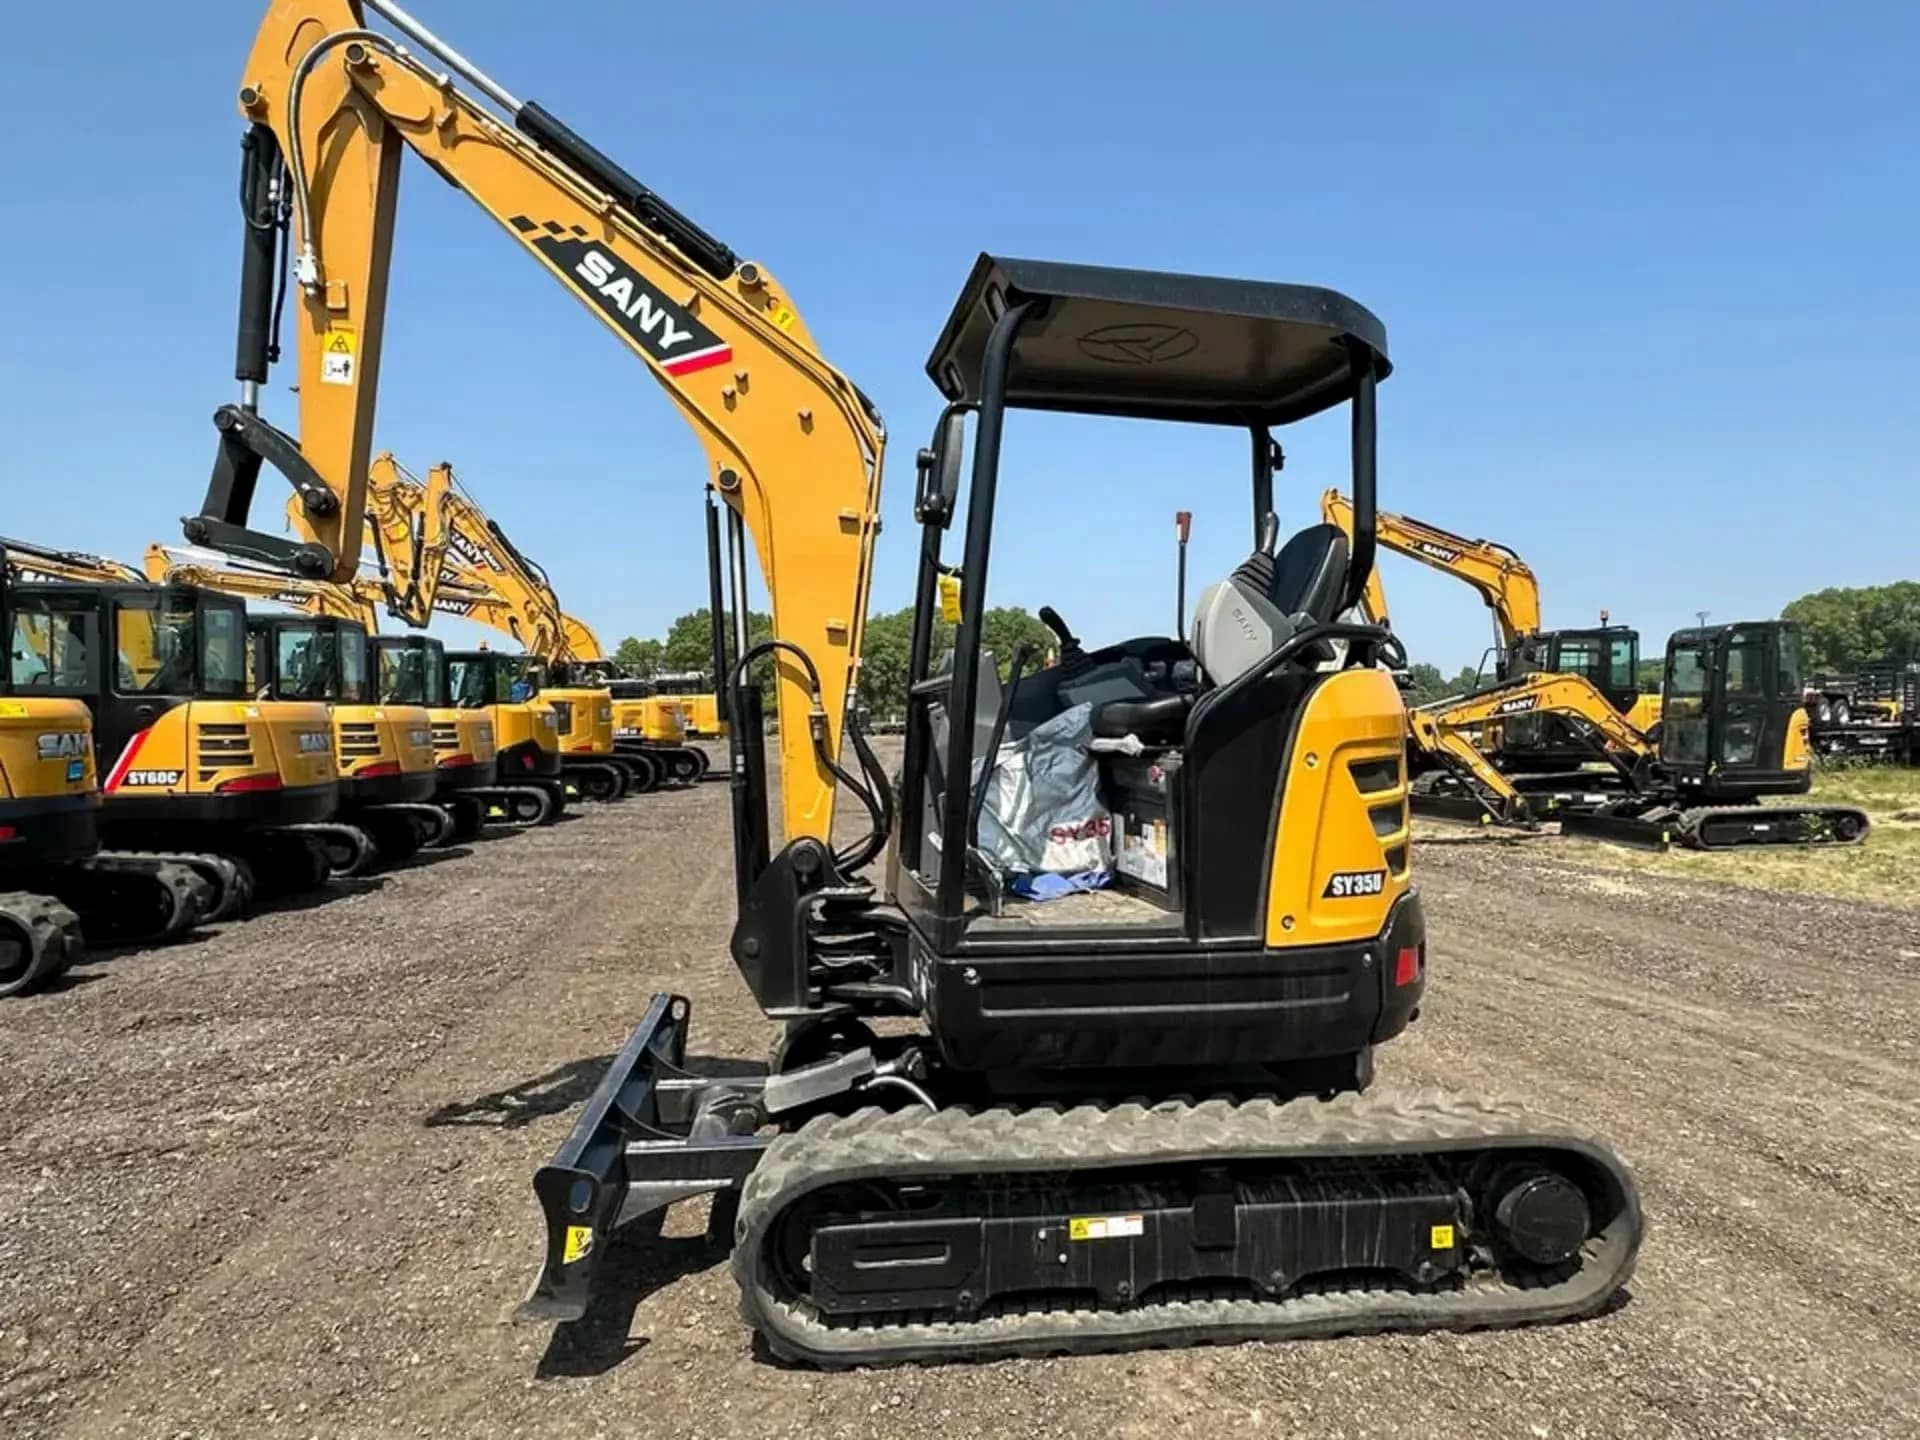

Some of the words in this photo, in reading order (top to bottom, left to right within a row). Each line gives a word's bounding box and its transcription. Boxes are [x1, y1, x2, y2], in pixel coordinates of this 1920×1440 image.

[575, 250, 693, 350] SANY
[128, 771, 177, 784] SY60C
[1332, 873, 1382, 895] SY35U
